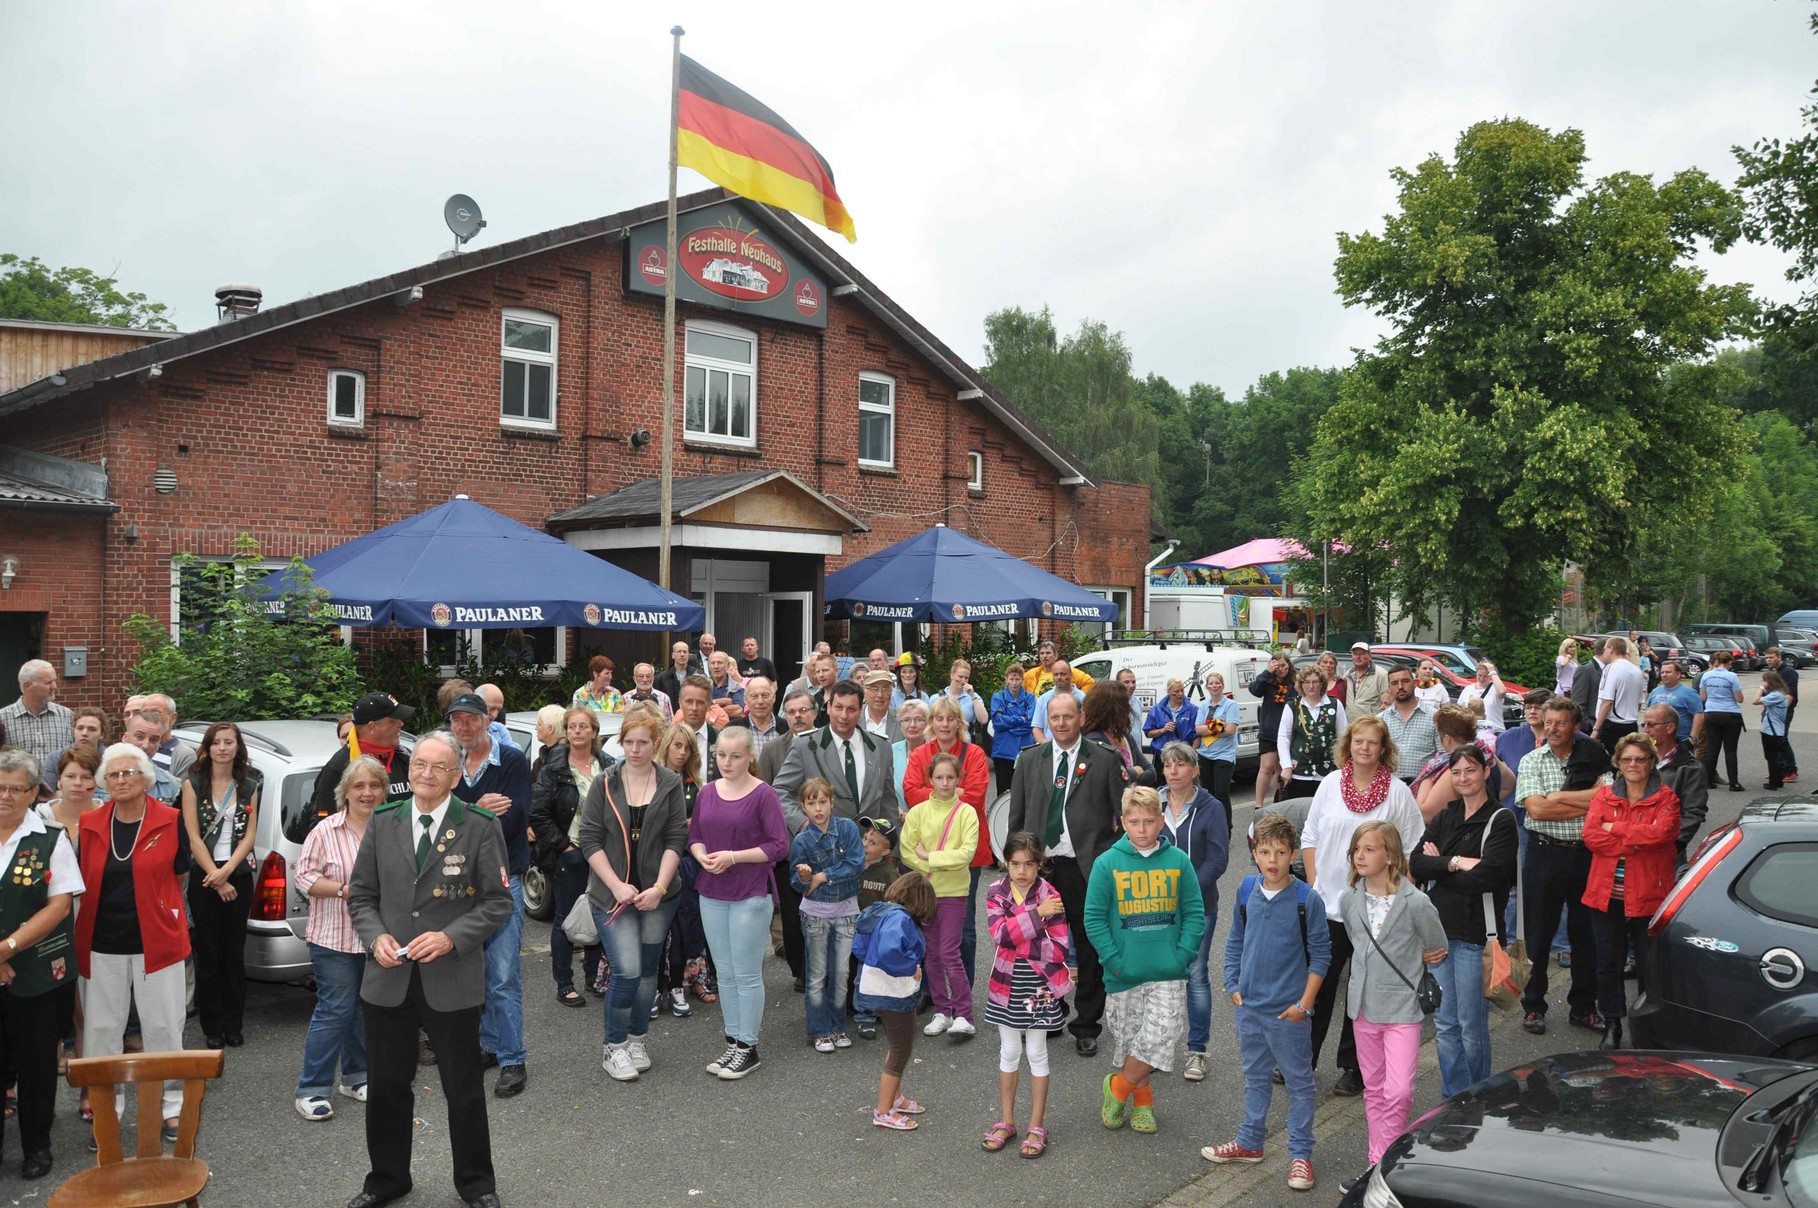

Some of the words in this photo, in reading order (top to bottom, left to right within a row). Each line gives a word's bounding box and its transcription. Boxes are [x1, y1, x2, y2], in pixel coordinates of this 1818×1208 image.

[688, 237, 737, 254] Festhalle
[741, 241, 782, 273] Neuhaus
[644, 266, 665, 275] ASTRA
[454, 606, 545, 622] PAULANER
[603, 608, 678, 626] PAULANER
[866, 604, 913, 618] PAULANER
[965, 603, 1020, 617] PAULANER
[1053, 604, 1101, 617] PAULANER
[863, 880, 886, 891] ROUTE
[1113, 869, 1180, 900] FORT
[1118, 897, 1178, 914] AUGUSTUS
